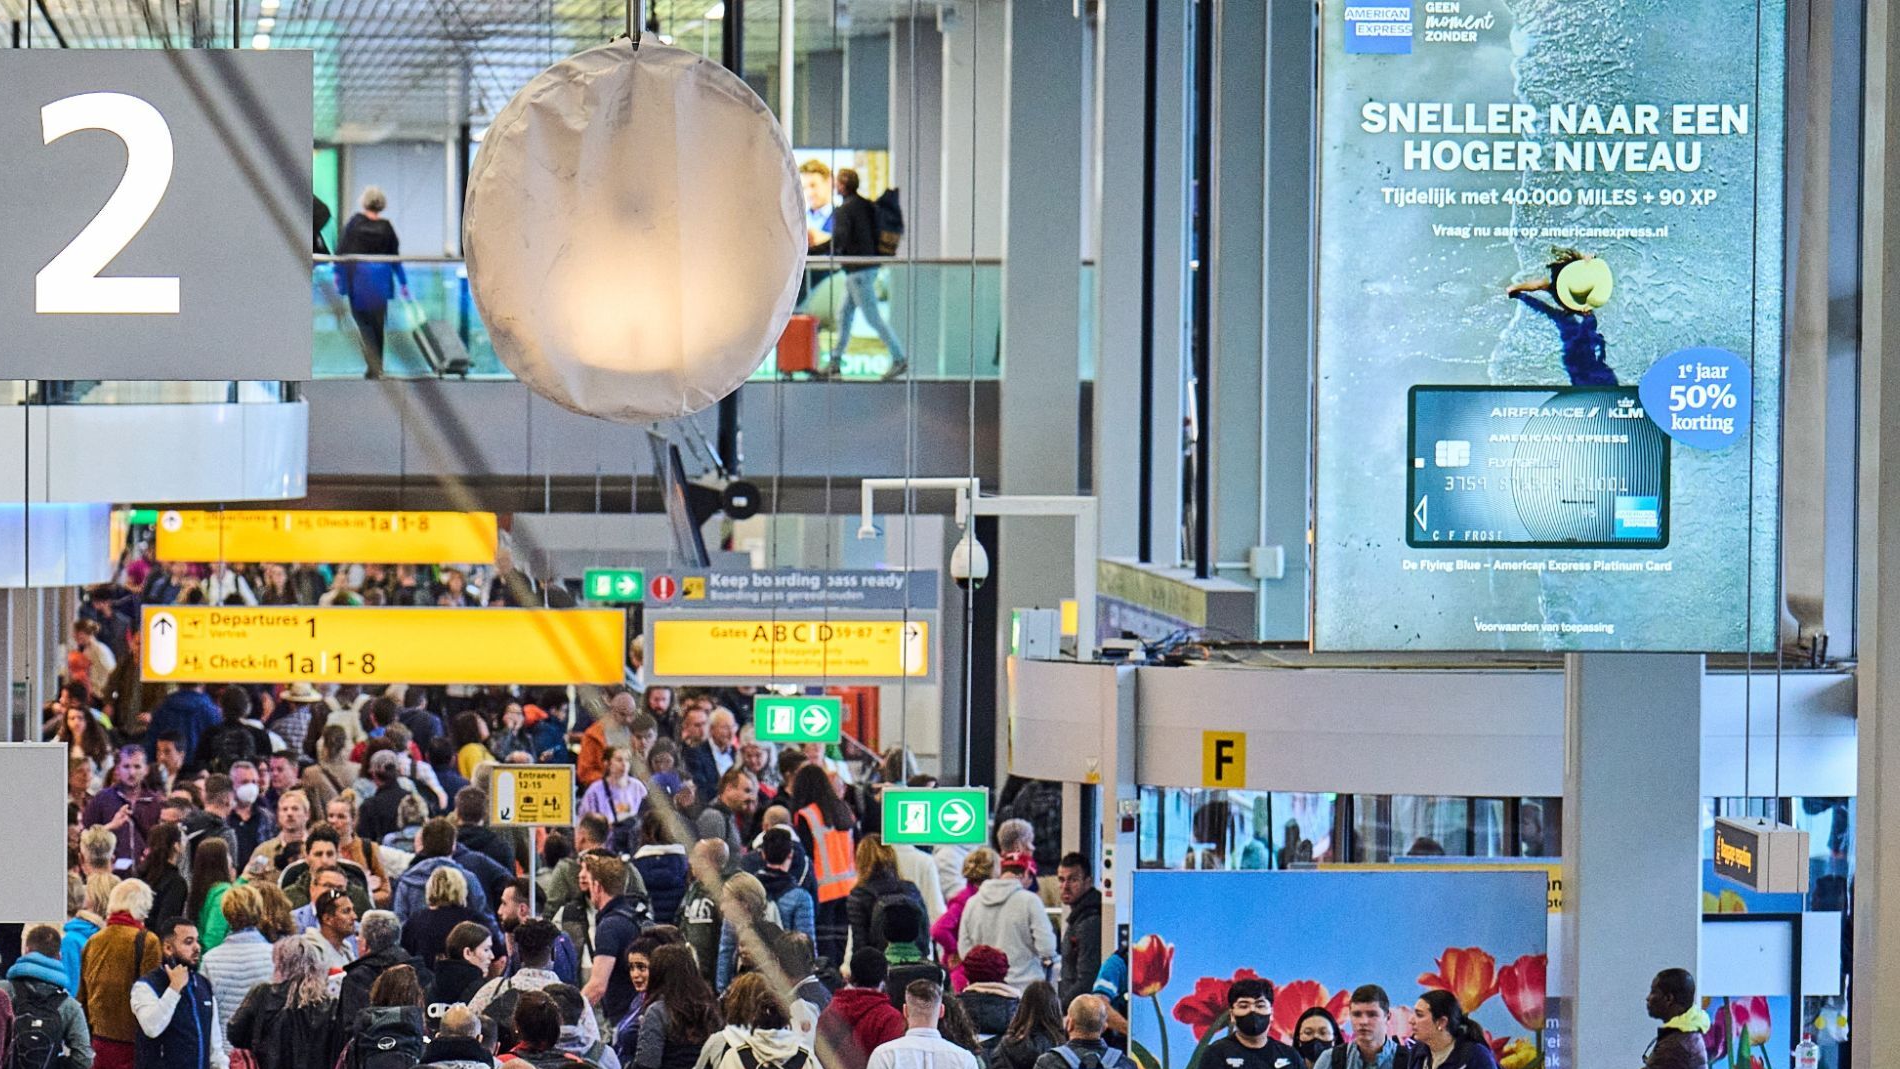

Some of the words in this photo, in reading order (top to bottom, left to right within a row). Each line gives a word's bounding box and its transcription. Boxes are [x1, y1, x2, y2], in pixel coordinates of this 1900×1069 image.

[1345, 8, 1409, 20] AMERICAN
[1425, 2, 1460, 13] GEEN
[1425, 11, 1495, 30] moment
[1357, 24, 1413, 35] EXPRESS
[1425, 31, 1477, 42] ZONDER
[1360, 102, 1536, 135] SNELLER
[1549, 104, 1659, 135] NAAR
[1672, 104, 1749, 135] EEN
[1403, 141, 1542, 172] HOGER
[1555, 141, 1702, 172] NIVEAU
[34, 91, 181, 315] 2
[1381, 188, 1456, 208] Tijdelijk
[1461, 190, 1498, 205] met
[1502, 188, 1572, 205] 40.000
[1577, 188, 1637, 205] MILES
[1643, 192, 1655, 203] +
[1659, 188, 1683, 205] 90
[1690, 189, 1717, 205] XP
[1432, 225, 1471, 239] Vraag
[1473, 227, 1491, 237] nu
[1493, 227, 1517, 237] aan
[1520, 227, 1538, 240] op
[1541, 225, 1669, 240] americanexpress.nl
[1696, 364, 1728, 382] jaar
[1669, 384, 1737, 412] 50%
[1490, 407, 1584, 418] AIRFRANCE
[1608, 407, 1644, 418] KLM
[1671, 413, 1734, 435] korting
[1488, 434, 1562, 443] AMERICAN
[1444, 476, 1487, 491] 3759
[1402, 561, 1418, 571] De
[1420, 560, 1454, 572] Flying
[1456, 560, 1481, 571] Blue
[1493, 560, 1546, 571] American
[1548, 560, 1591, 573] Express
[1593, 560, 1643, 571] Platinum
[1646, 560, 1672, 571] Card
[710, 573, 749, 590] Keep
[862, 572, 903, 591] ready
[210, 613, 299, 628] Departures
[305, 617, 317, 639] 1
[711, 627, 748, 639] Gates
[752, 625, 768, 642] A
[775, 625, 787, 642] B
[793, 625, 808, 642] C
[818, 625, 833, 642] D
[1541, 622, 1559, 632] van
[1561, 622, 1615, 634] toepassing
[210, 655, 278, 670] Check-in
[285, 653, 314, 674] 1a
[332, 653, 376, 675] 1-8
[1215, 739, 1234, 781] F
[518, 771, 556, 780] Entrance
